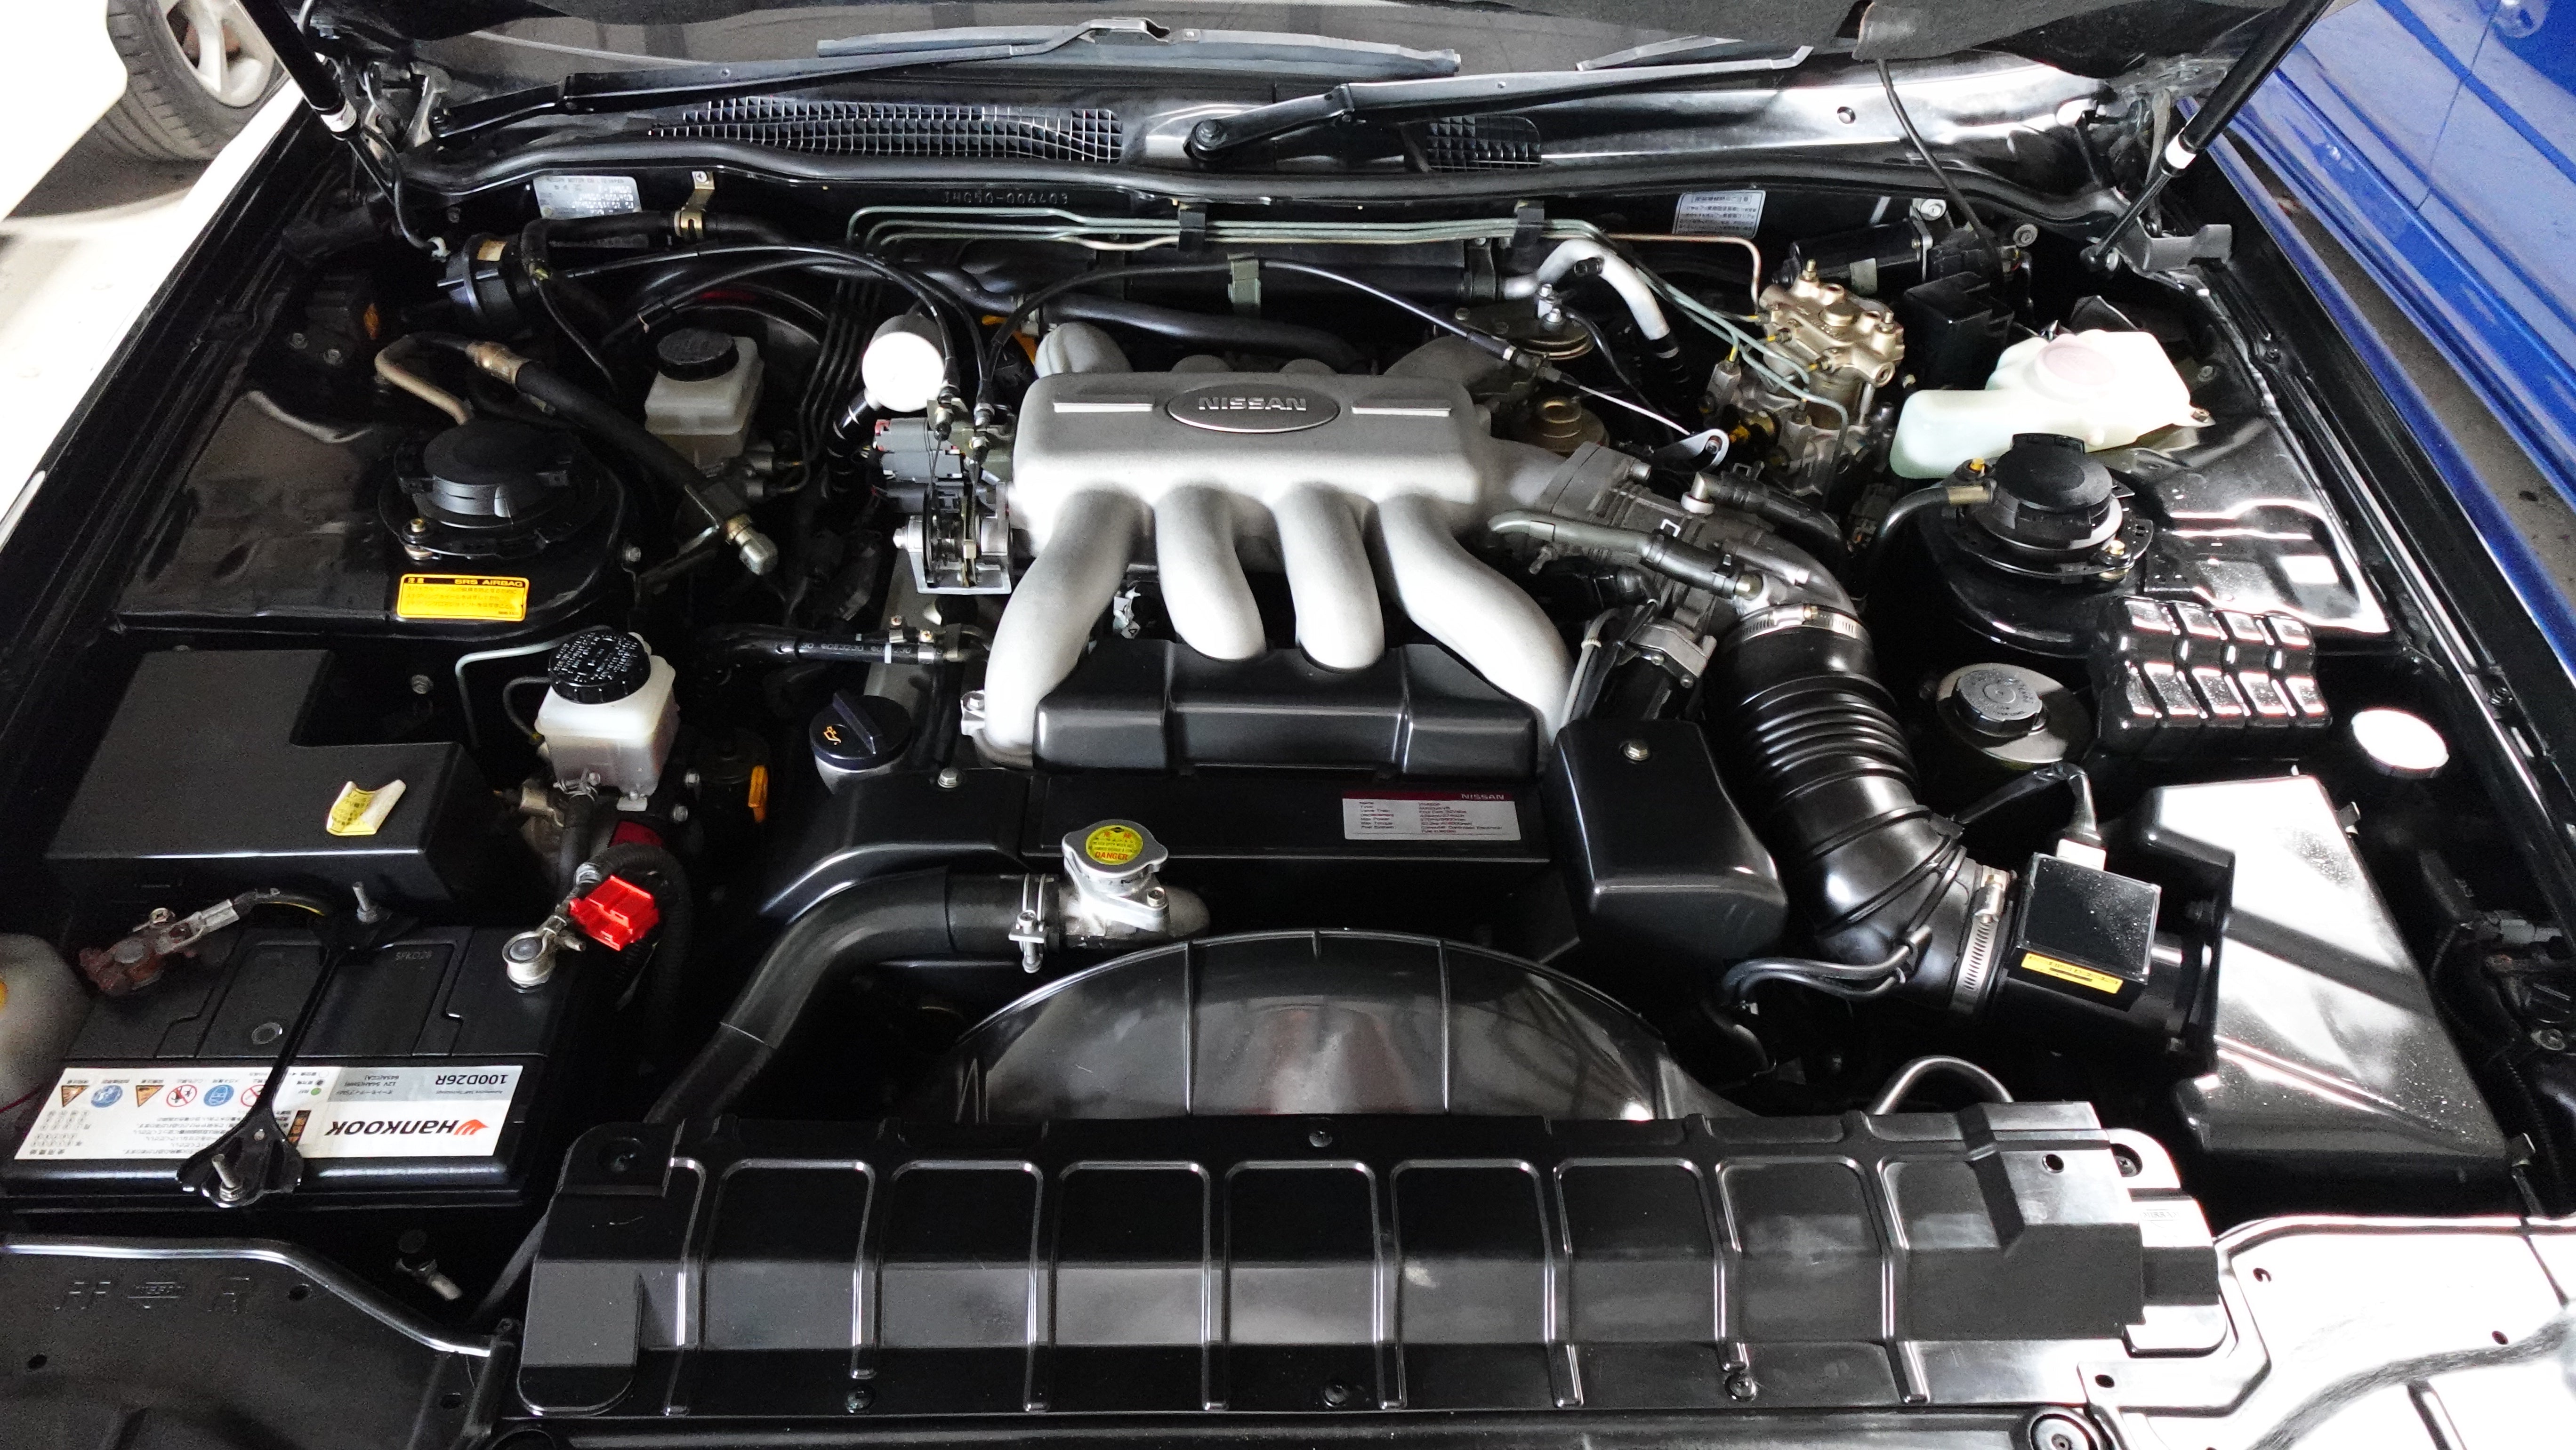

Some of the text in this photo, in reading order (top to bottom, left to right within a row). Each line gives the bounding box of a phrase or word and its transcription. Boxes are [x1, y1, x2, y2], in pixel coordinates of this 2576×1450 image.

[1198, 396, 1307, 412] NISSAN
[1095, 852, 1128, 860] DANGER
[435, 1074, 508, 1085] 100D26R
